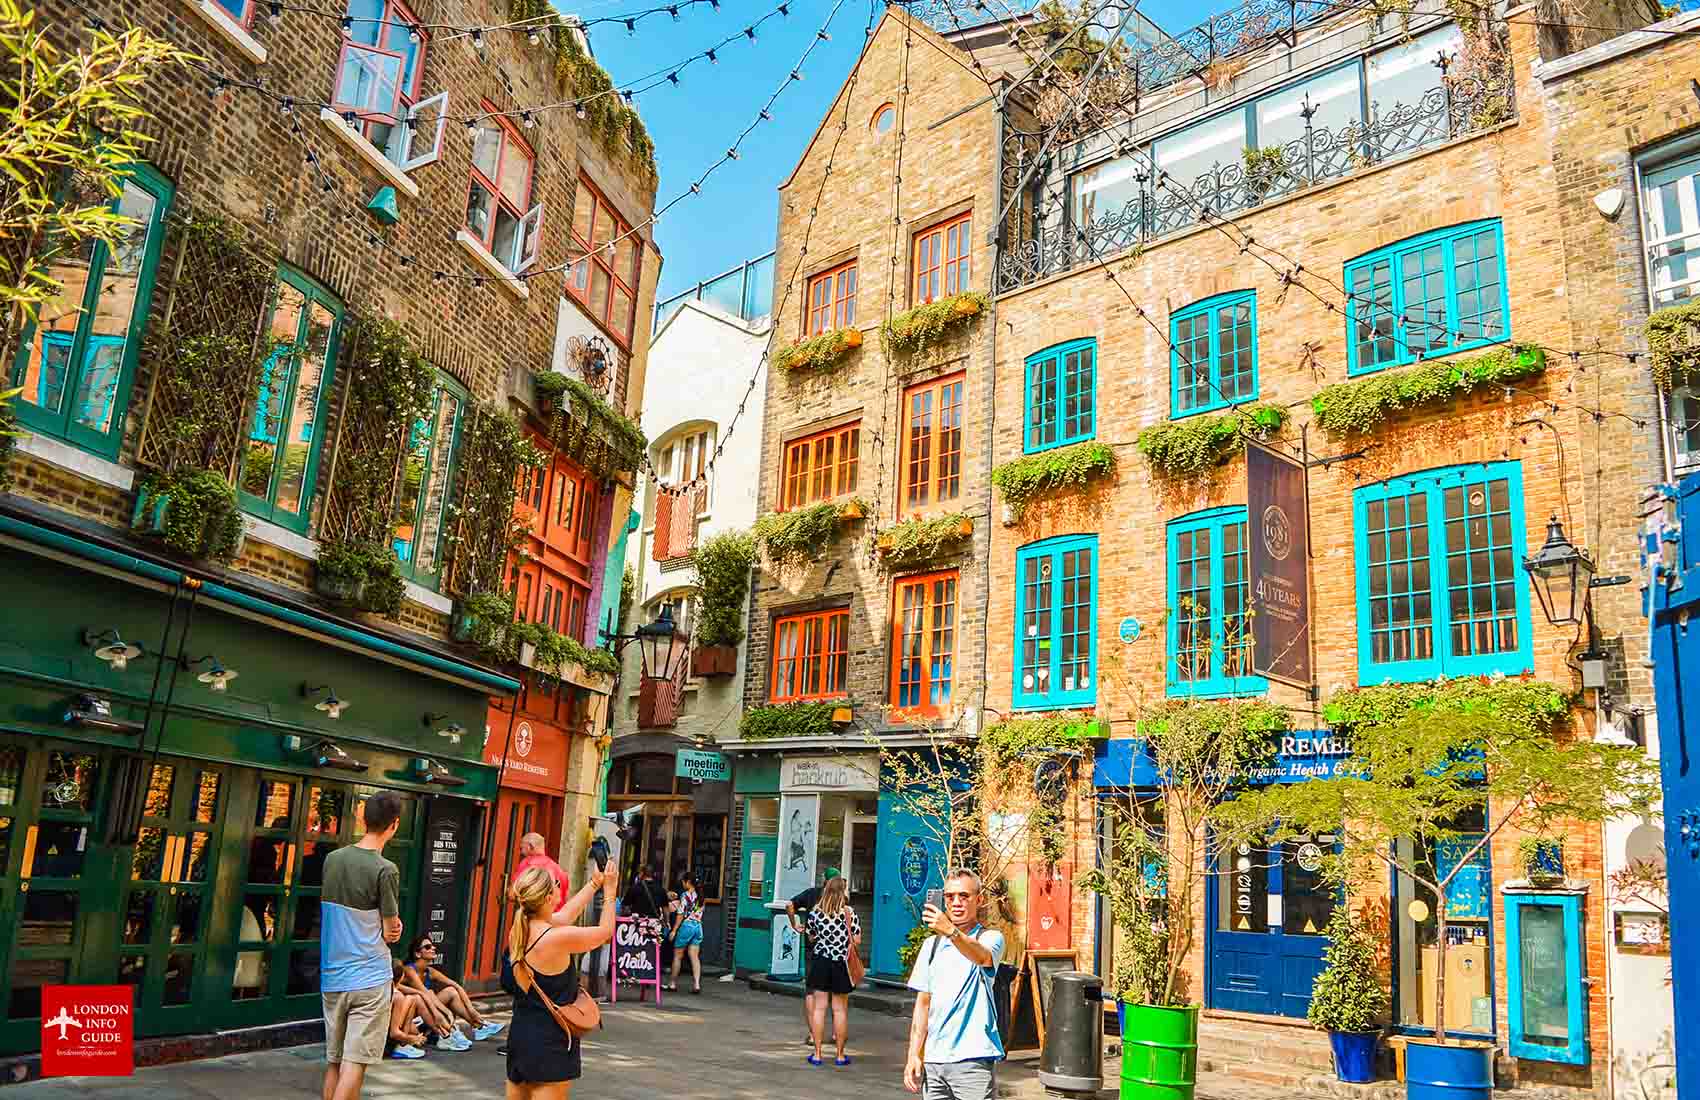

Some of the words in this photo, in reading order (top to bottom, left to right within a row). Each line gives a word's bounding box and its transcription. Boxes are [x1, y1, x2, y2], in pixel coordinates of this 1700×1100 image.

[1265, 524, 1288, 544] 1981
[1256, 579, 1272, 602] 40
[1272, 587, 1302, 609] YEARS
[684, 759, 726, 773] meeting
[689, 768, 720, 778] rooms
[1290, 762, 1330, 777] Health
